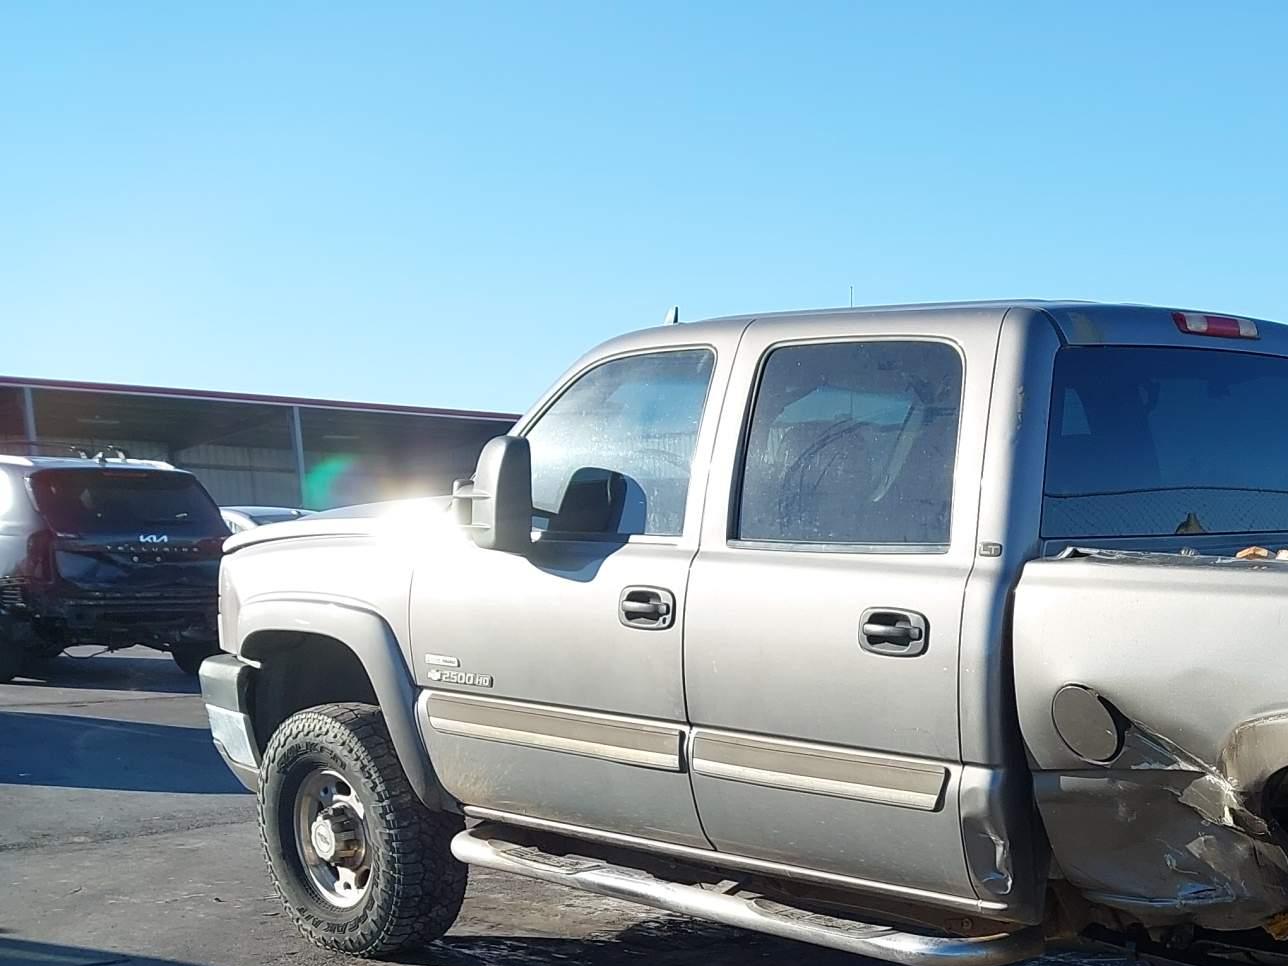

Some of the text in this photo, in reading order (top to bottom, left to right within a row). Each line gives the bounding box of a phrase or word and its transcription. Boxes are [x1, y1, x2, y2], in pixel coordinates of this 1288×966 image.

[979, 543, 1001, 556] LT
[442, 670, 490, 687] 2500 HD
